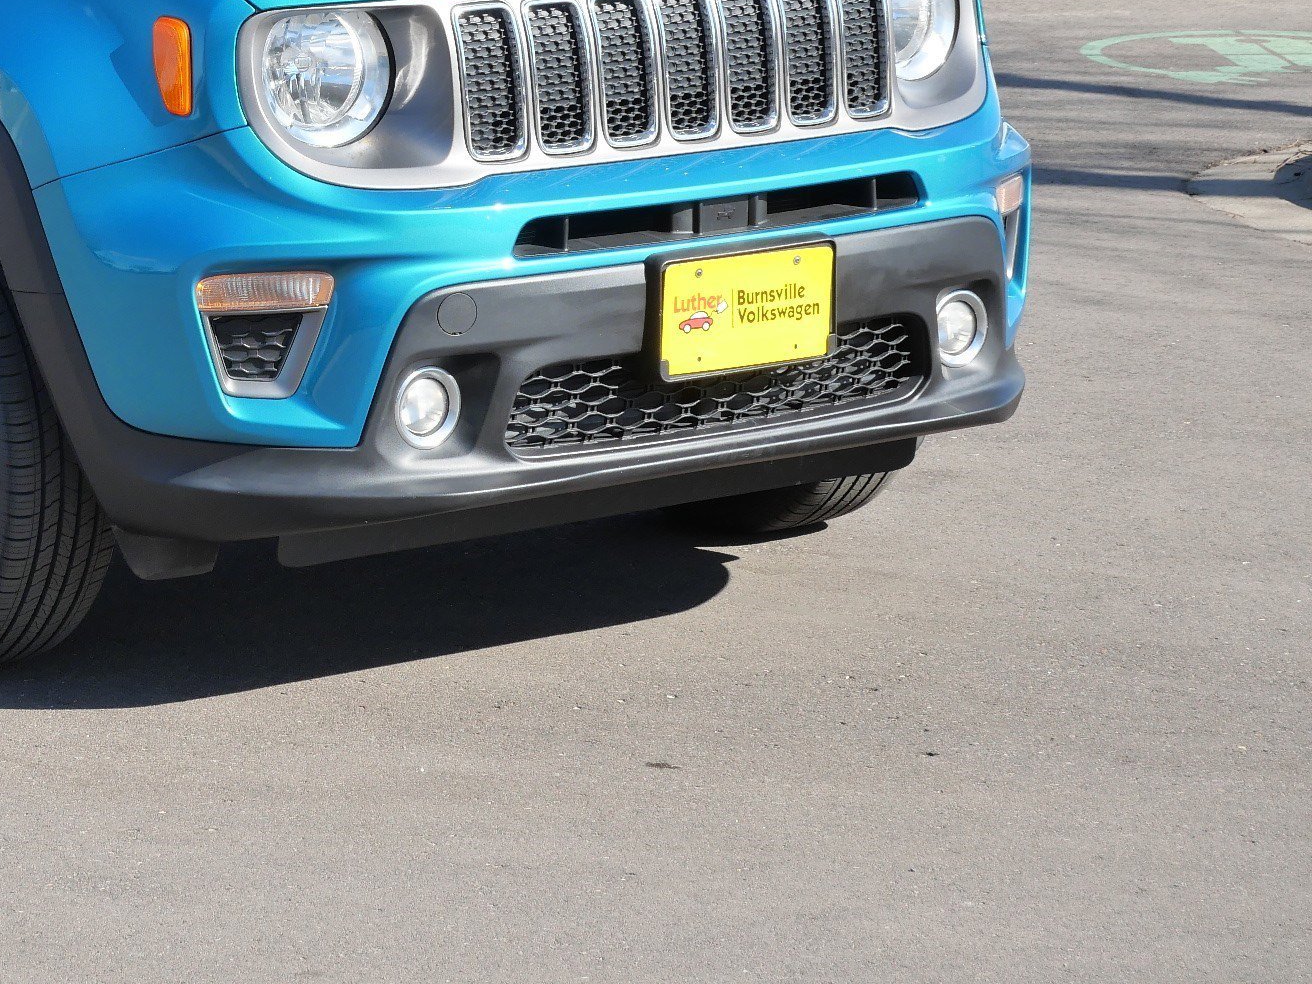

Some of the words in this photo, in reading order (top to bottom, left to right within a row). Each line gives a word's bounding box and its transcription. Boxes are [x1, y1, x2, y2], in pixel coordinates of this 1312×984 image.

[673, 293, 723, 314] Luther
[736, 283, 806, 306] Burnsville
[736, 301, 820, 325] Volkswagen
